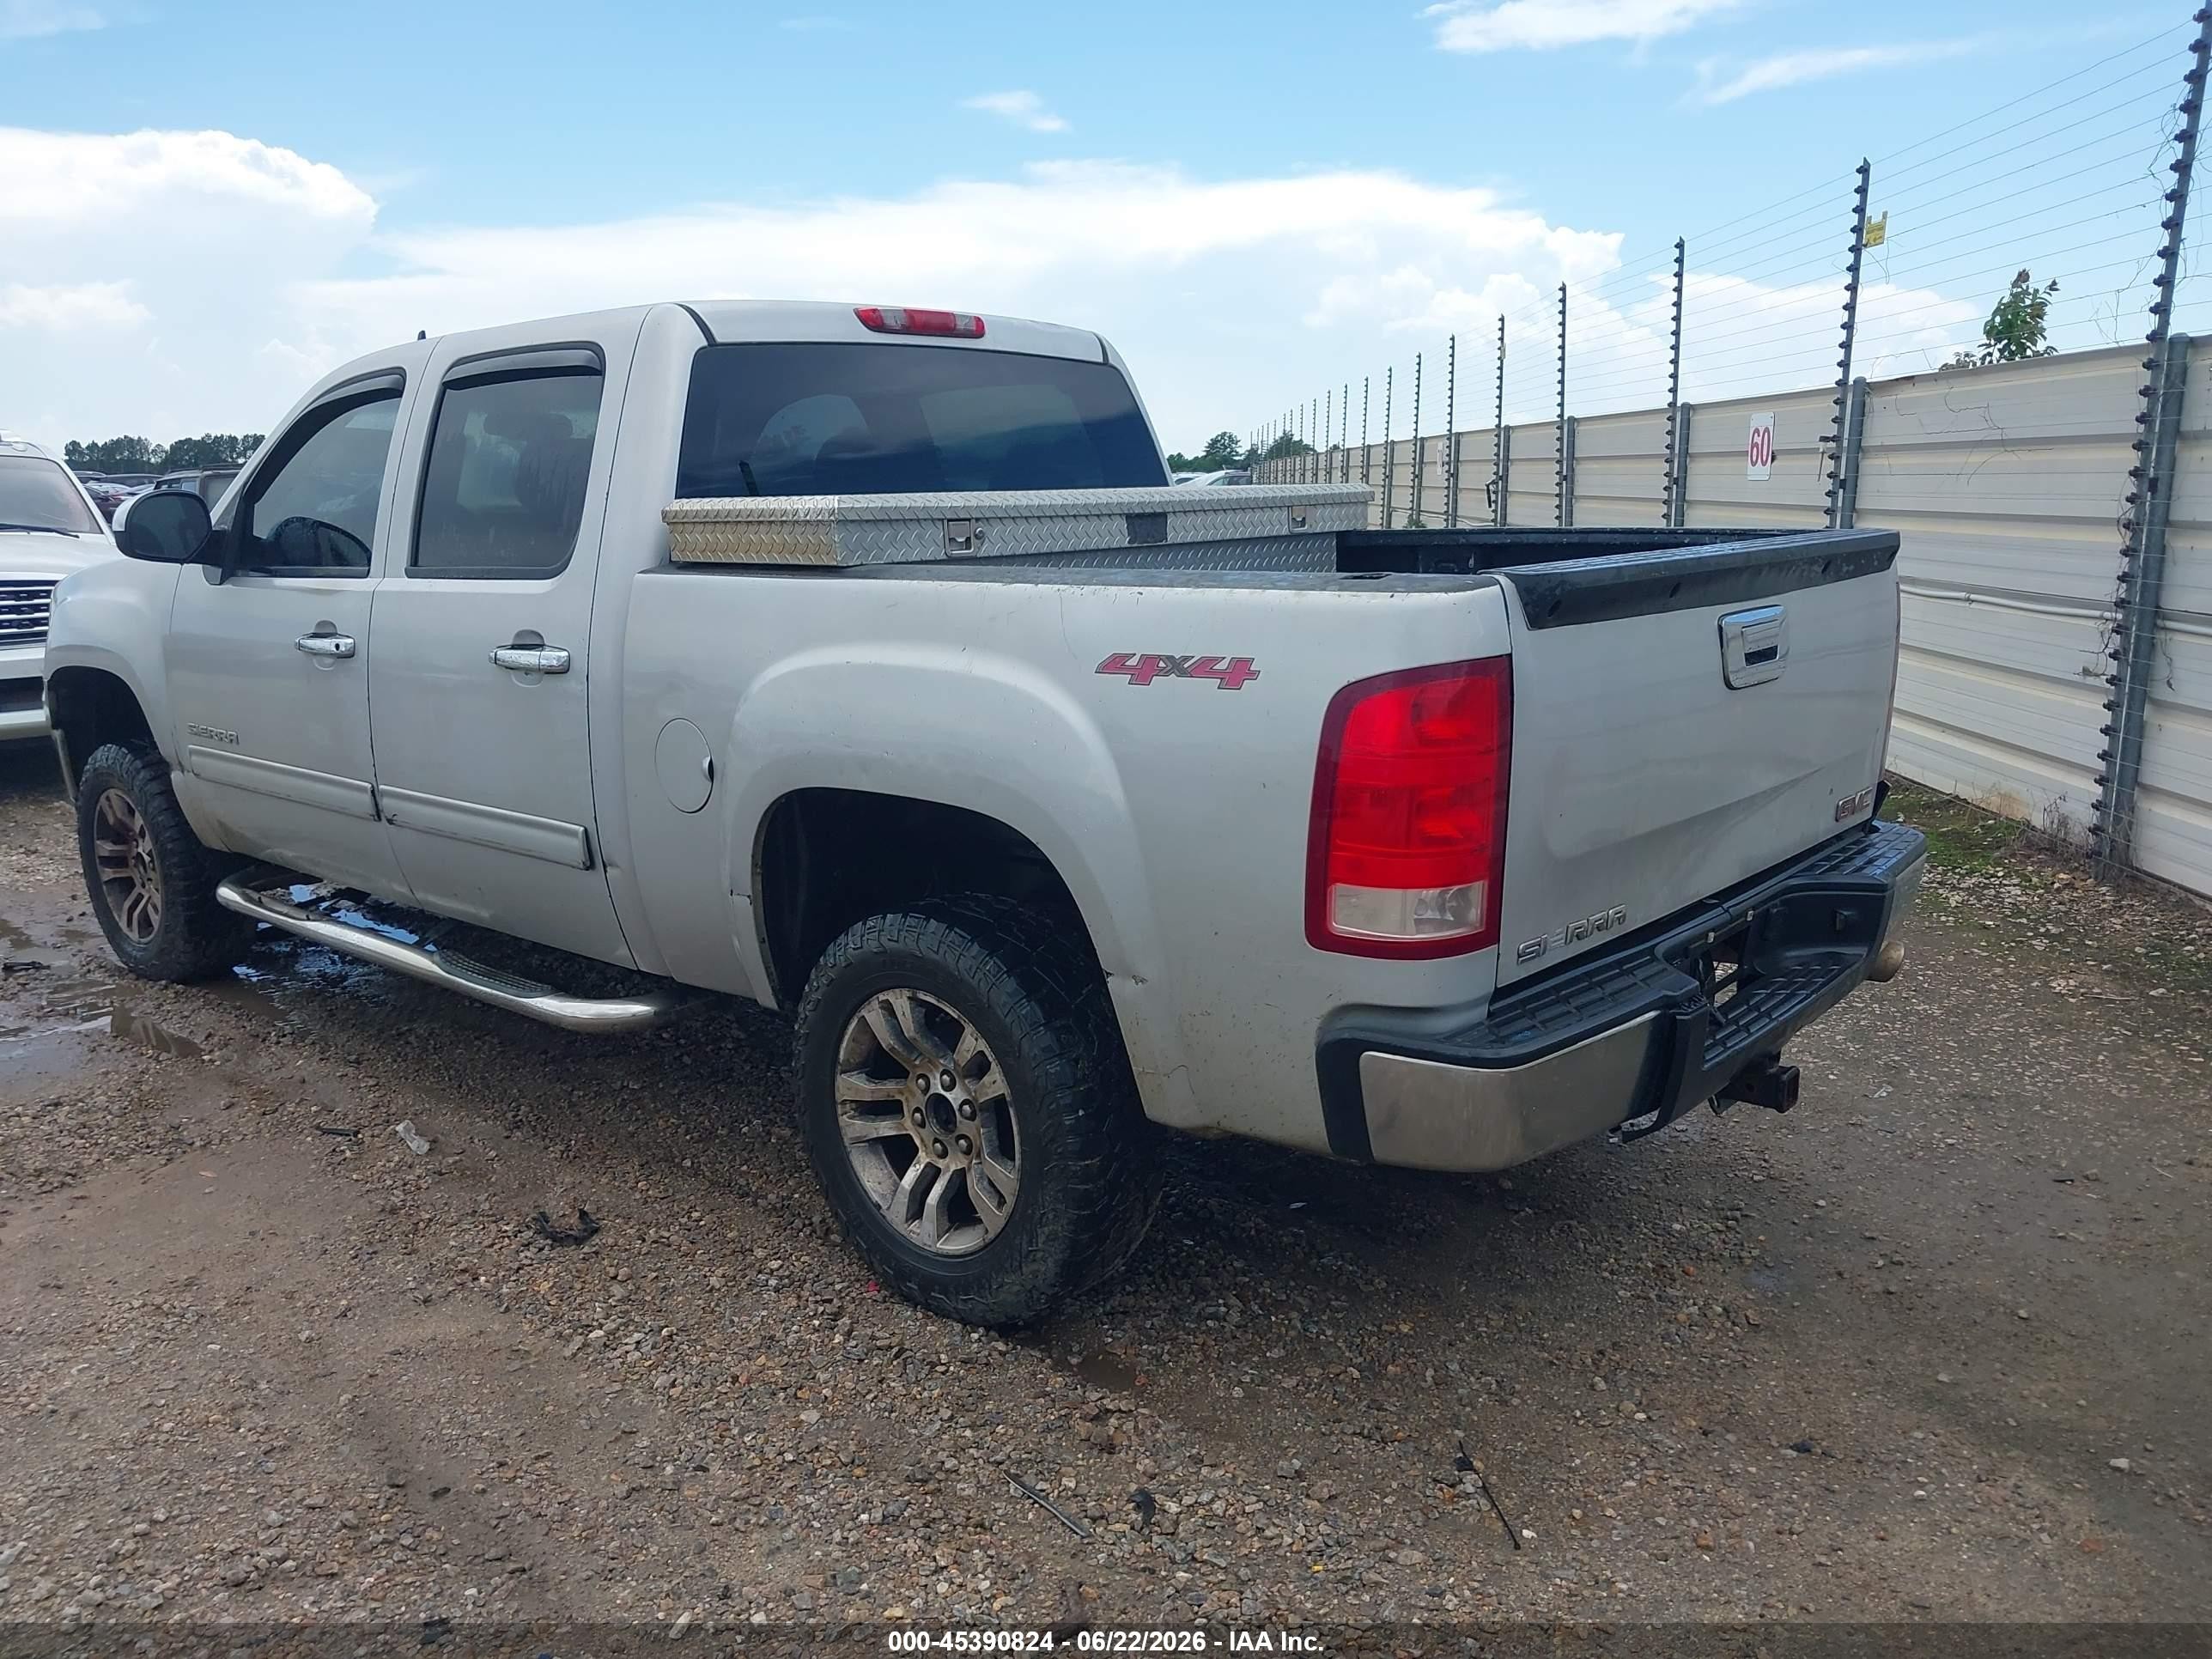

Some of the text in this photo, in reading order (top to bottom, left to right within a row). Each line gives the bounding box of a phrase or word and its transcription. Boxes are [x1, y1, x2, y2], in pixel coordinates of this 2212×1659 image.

[1750, 427, 1771, 467] 60
[187, 722, 240, 745] SIERRA
[1836, 787, 1873, 822] GMC
[1516, 903, 1626, 966] SIERRA
